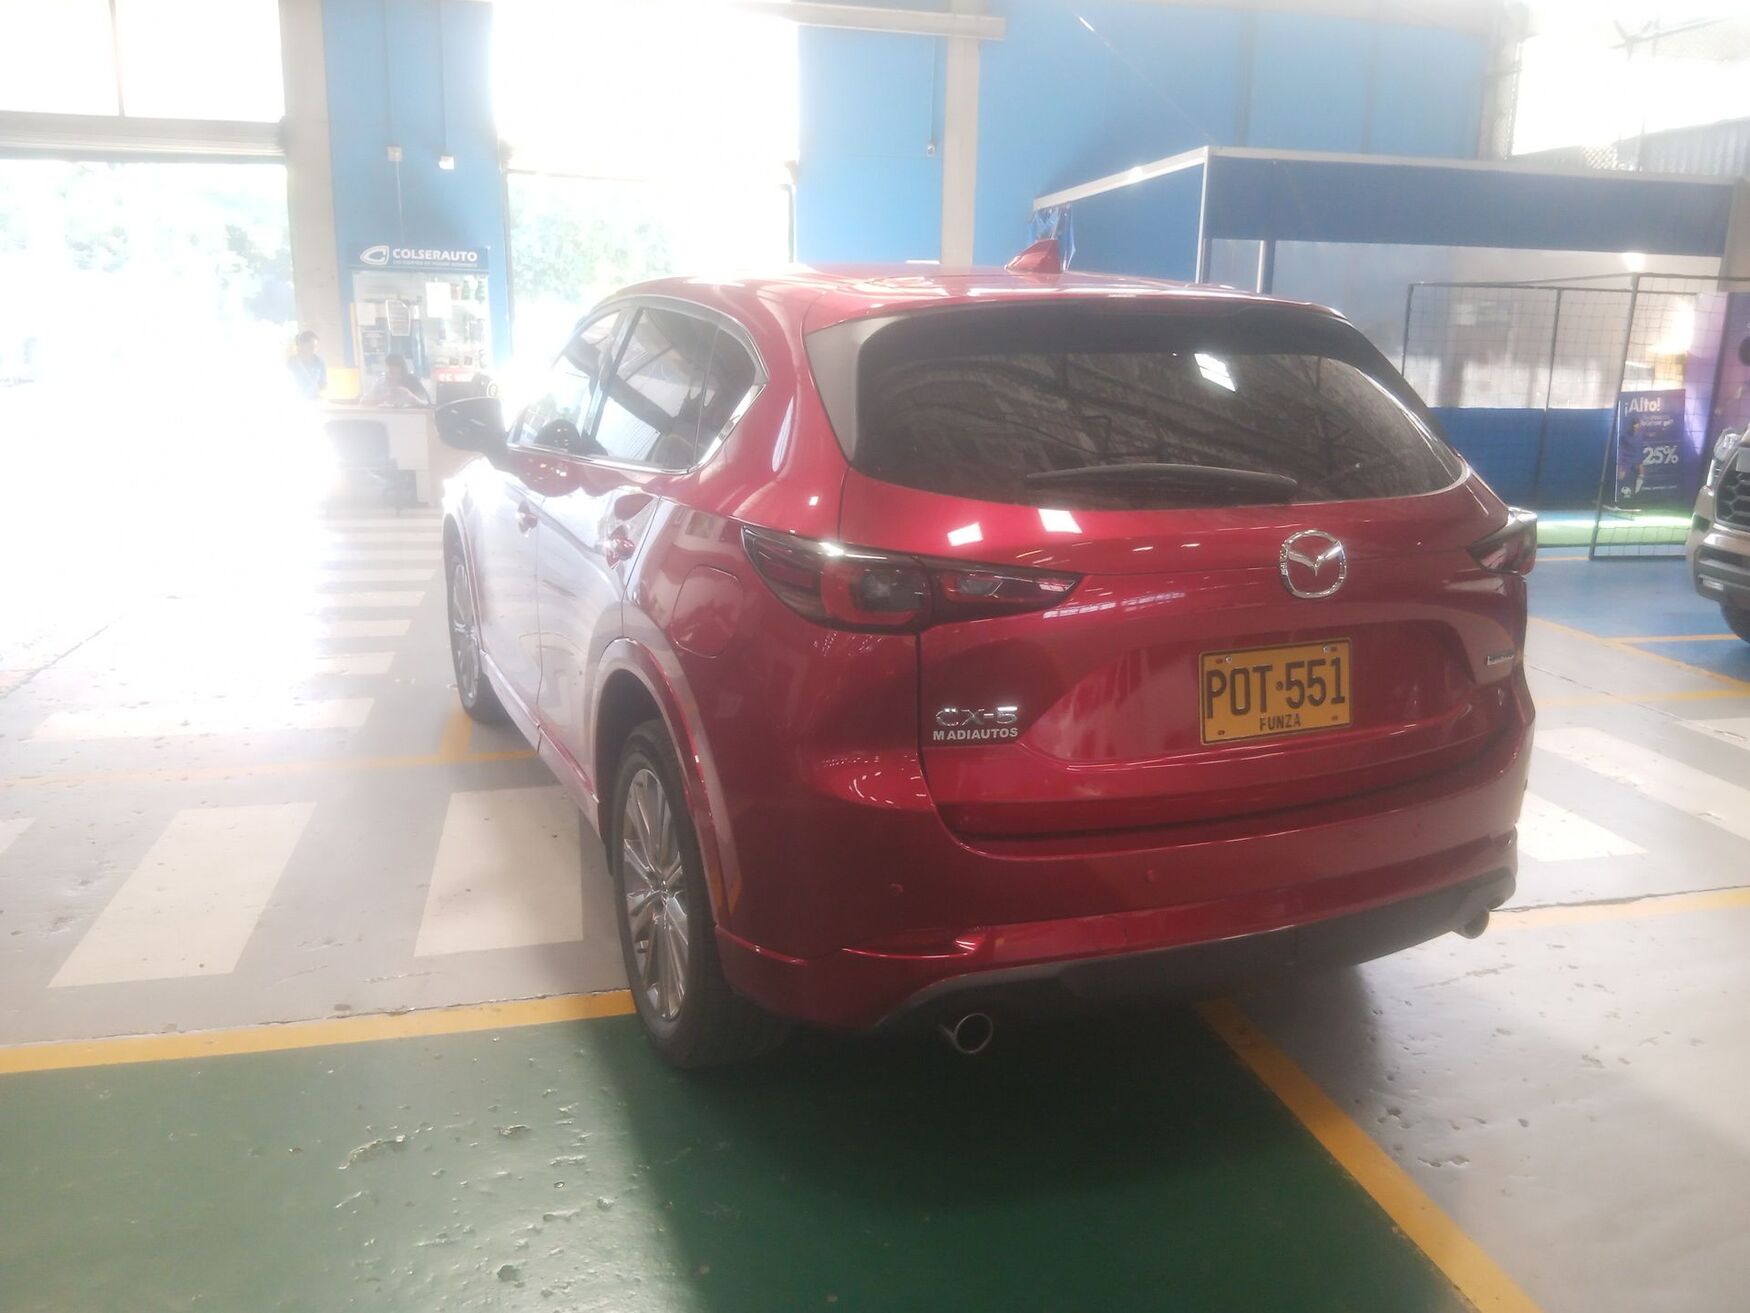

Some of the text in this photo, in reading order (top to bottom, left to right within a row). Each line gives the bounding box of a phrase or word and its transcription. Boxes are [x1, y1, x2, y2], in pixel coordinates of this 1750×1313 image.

[392, 248, 478, 262] COLSERAUTO
[1624, 398, 1661, 416] ¡Alto!
[1642, 445, 1679, 465] 25%
[935, 706, 1018, 727] CX-5
[1259, 714, 1301, 731] FUNZA
[933, 727, 1018, 741] MADIAUTOS
